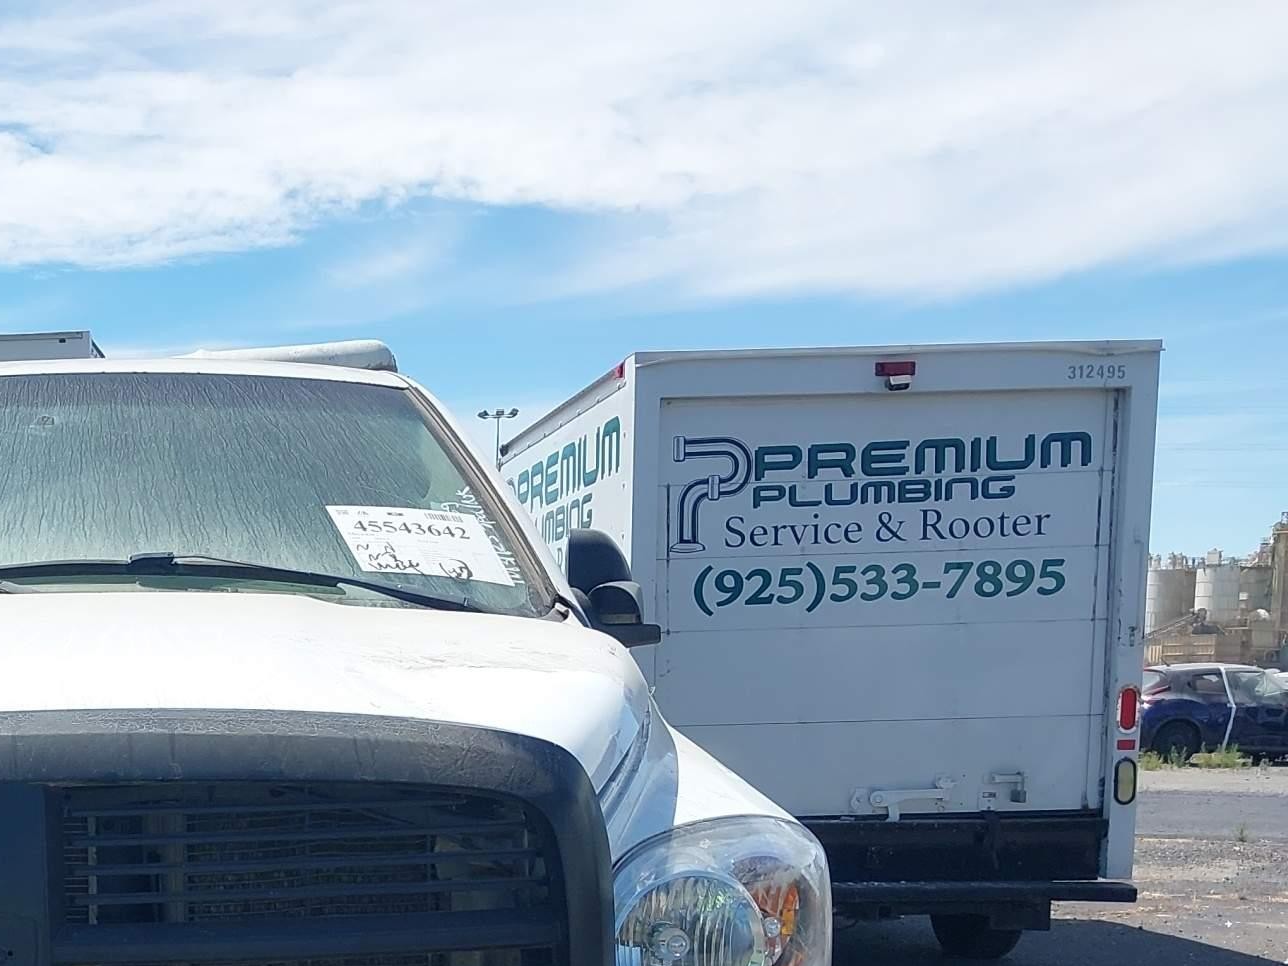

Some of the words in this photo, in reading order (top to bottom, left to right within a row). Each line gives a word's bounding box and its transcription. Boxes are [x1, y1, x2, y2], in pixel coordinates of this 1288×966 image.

[1067, 364, 1126, 380] 312495
[518, 416, 620, 513] PREMIUM
[754, 431, 1092, 481] PREMIUM
[752, 474, 1016, 508] PLUMBING
[353, 520, 470, 540] 45543642
[724, 512, 863, 549] Service
[875, 511, 907, 542] &
[919, 507, 1051, 541] Rooter
[693, 558, 1066, 616] (925)533-7895
